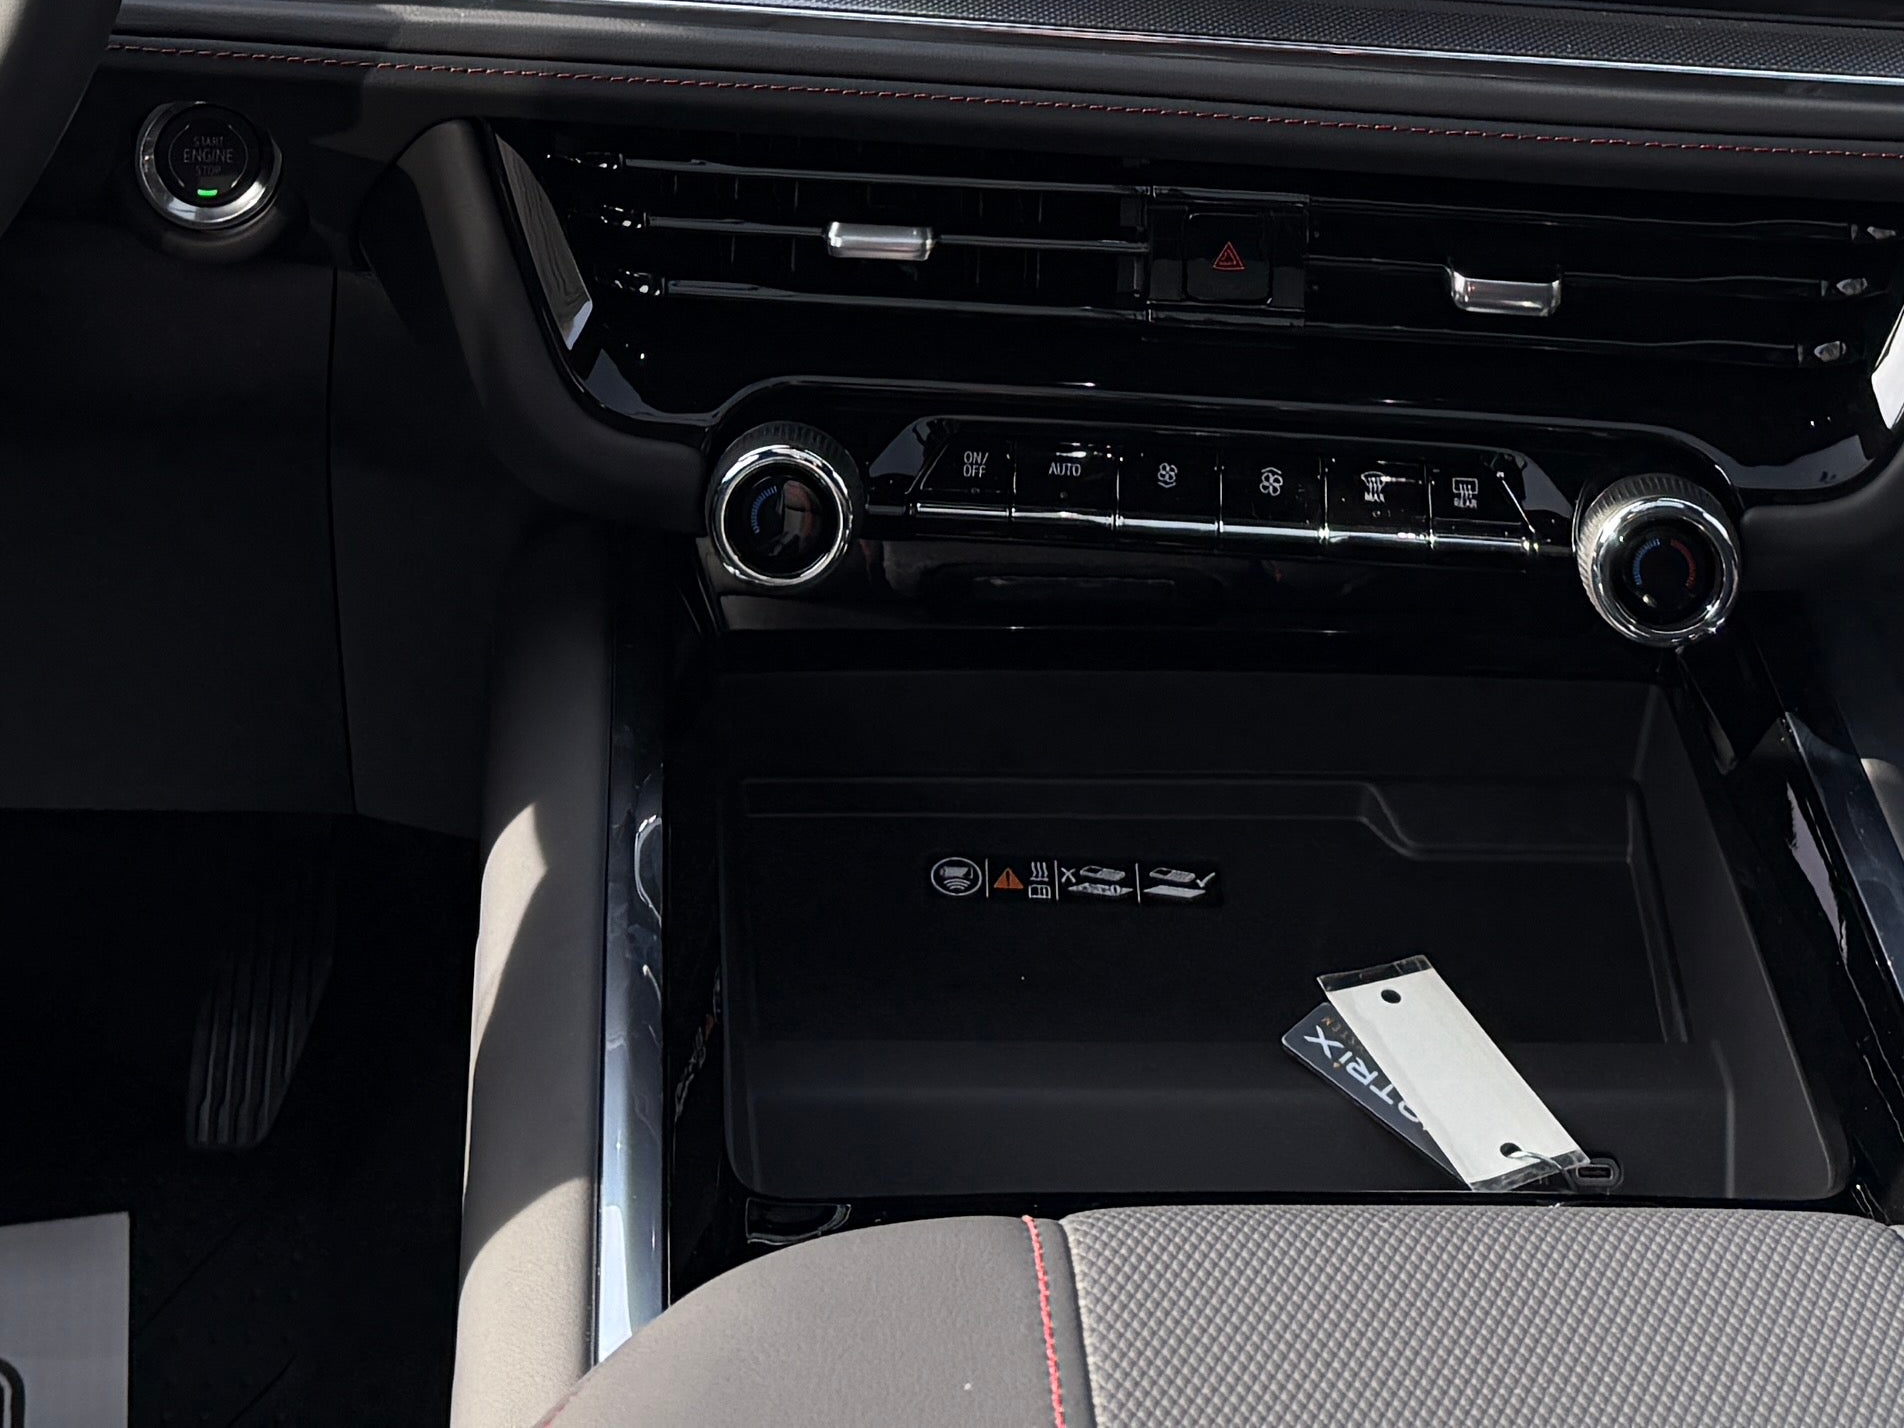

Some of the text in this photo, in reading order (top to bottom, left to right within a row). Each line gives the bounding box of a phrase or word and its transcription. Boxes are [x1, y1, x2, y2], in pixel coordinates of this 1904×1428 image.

[183, 147, 234, 164] ENGINE
[962, 449, 990, 465] ON/
[962, 463, 987, 479] OFF
[1048, 461, 1082, 477] AUTO
